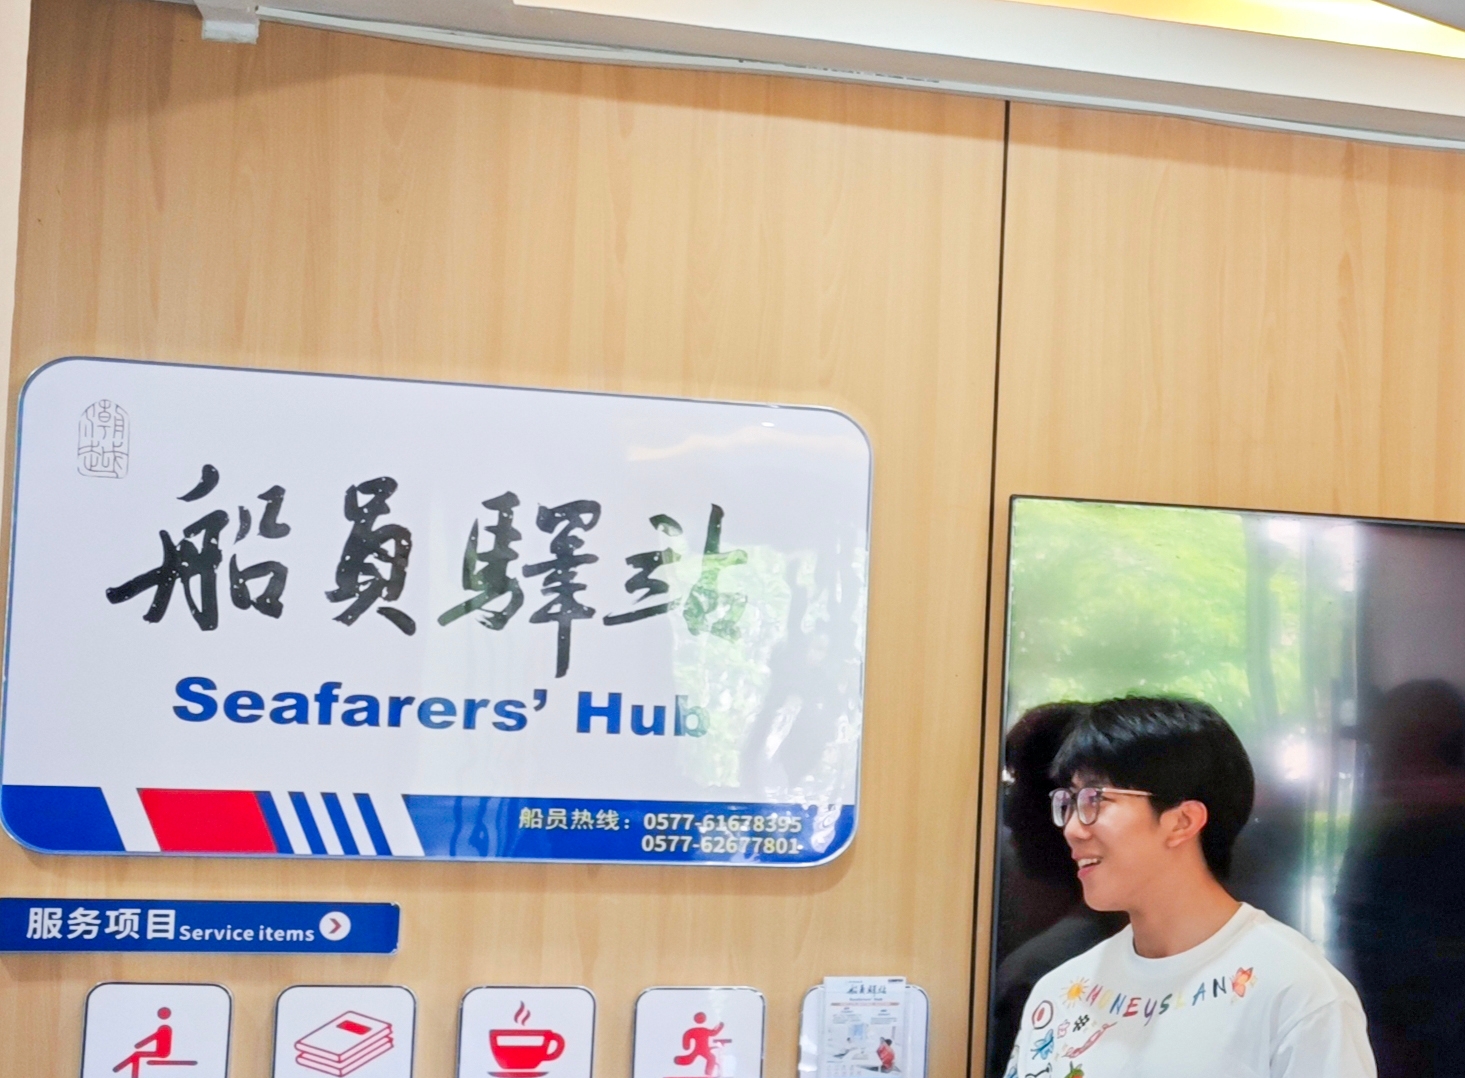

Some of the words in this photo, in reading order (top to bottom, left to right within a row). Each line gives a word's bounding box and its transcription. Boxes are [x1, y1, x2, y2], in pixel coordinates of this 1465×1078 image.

[576, 691, 711, 738] Hub
[641, 835, 801, 856] 0577-62677801
[26, 907, 177, 940] 服务项目
[179, 925, 254, 941] Service
[259, 925, 315, 942] items
